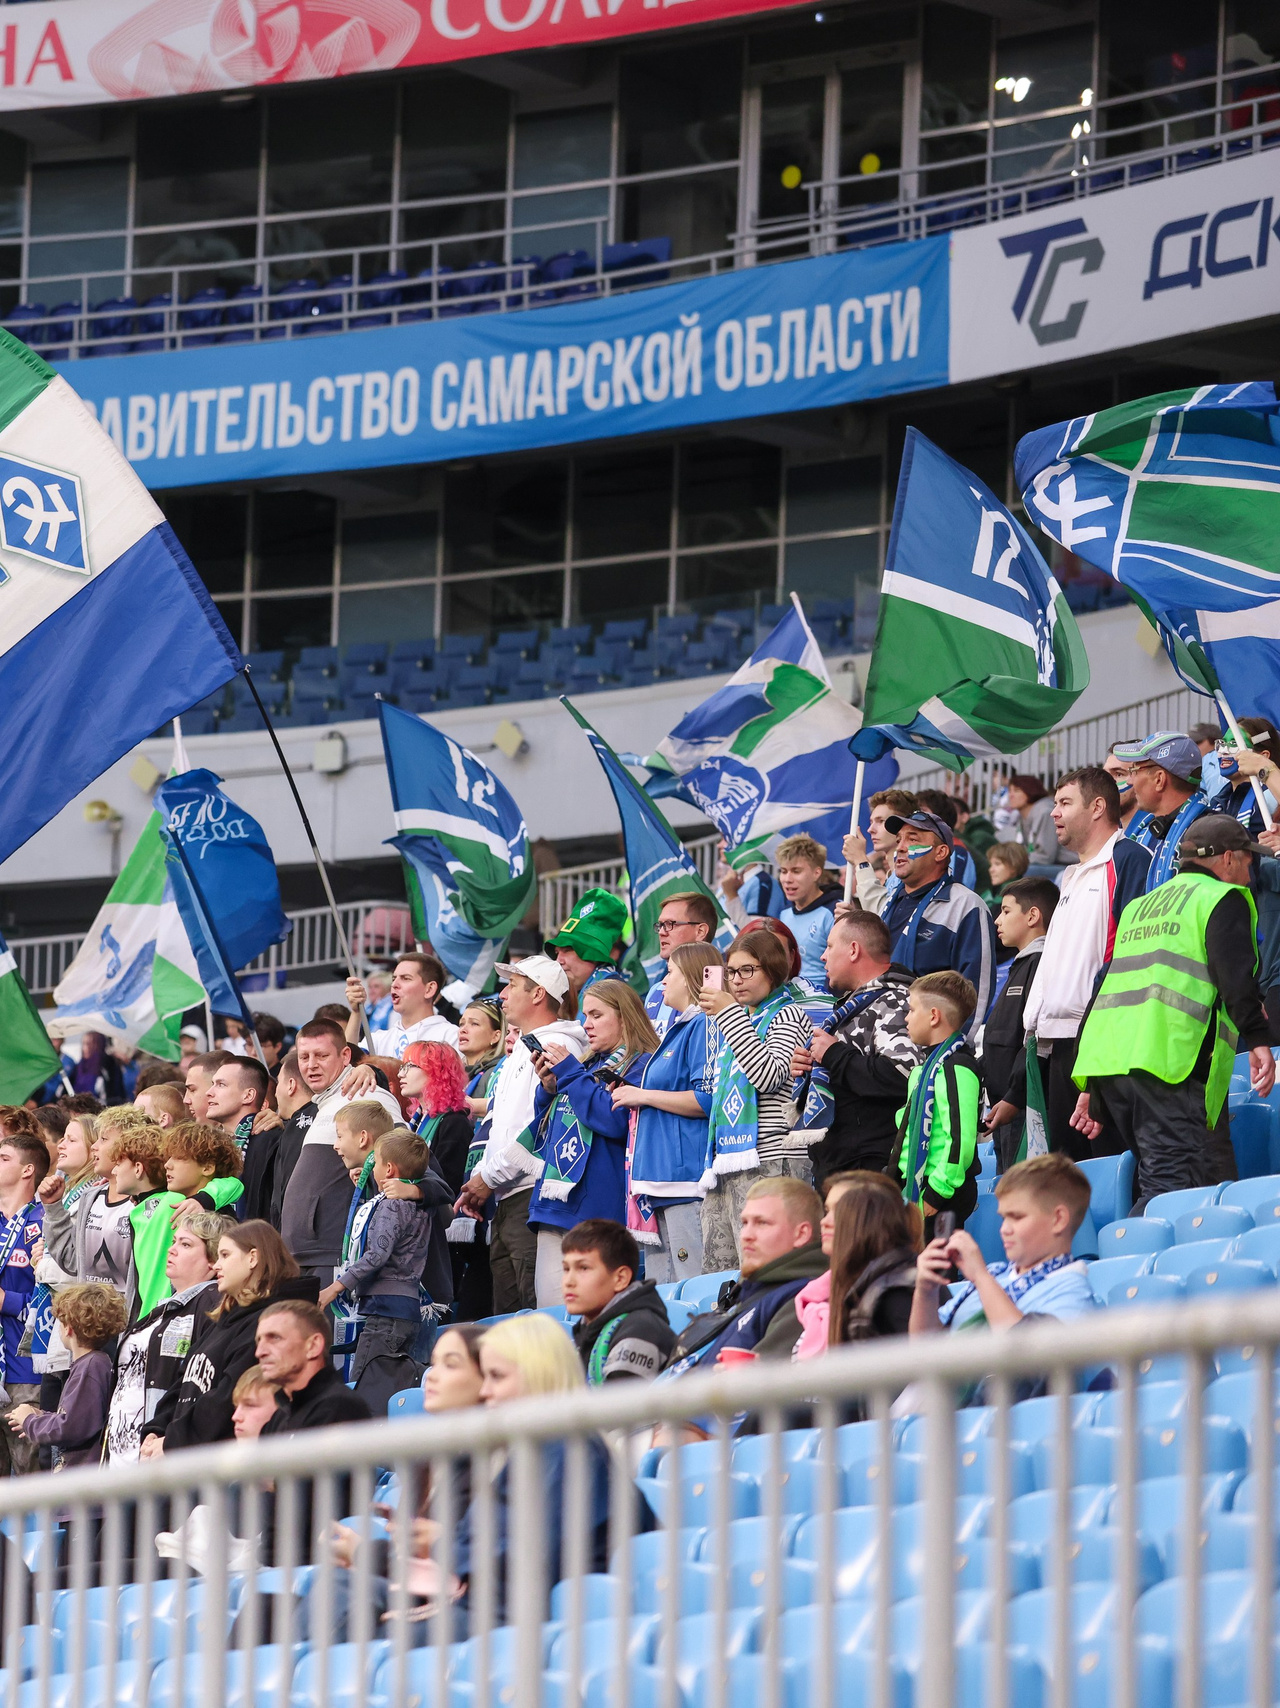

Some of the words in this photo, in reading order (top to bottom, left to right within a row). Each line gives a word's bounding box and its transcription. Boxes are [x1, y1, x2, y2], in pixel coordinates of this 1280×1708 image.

[83, 366, 421, 461] АВИТЕЛЬСТВО
[430, 314, 703, 433] САМАРСКОЙ
[714, 286, 922, 393] ОБЛАСТИ
[1130, 882, 1202, 925] 10201
[1120, 921, 1181, 944] STEWARD
[718, 1133, 754, 1147] САМАРА
